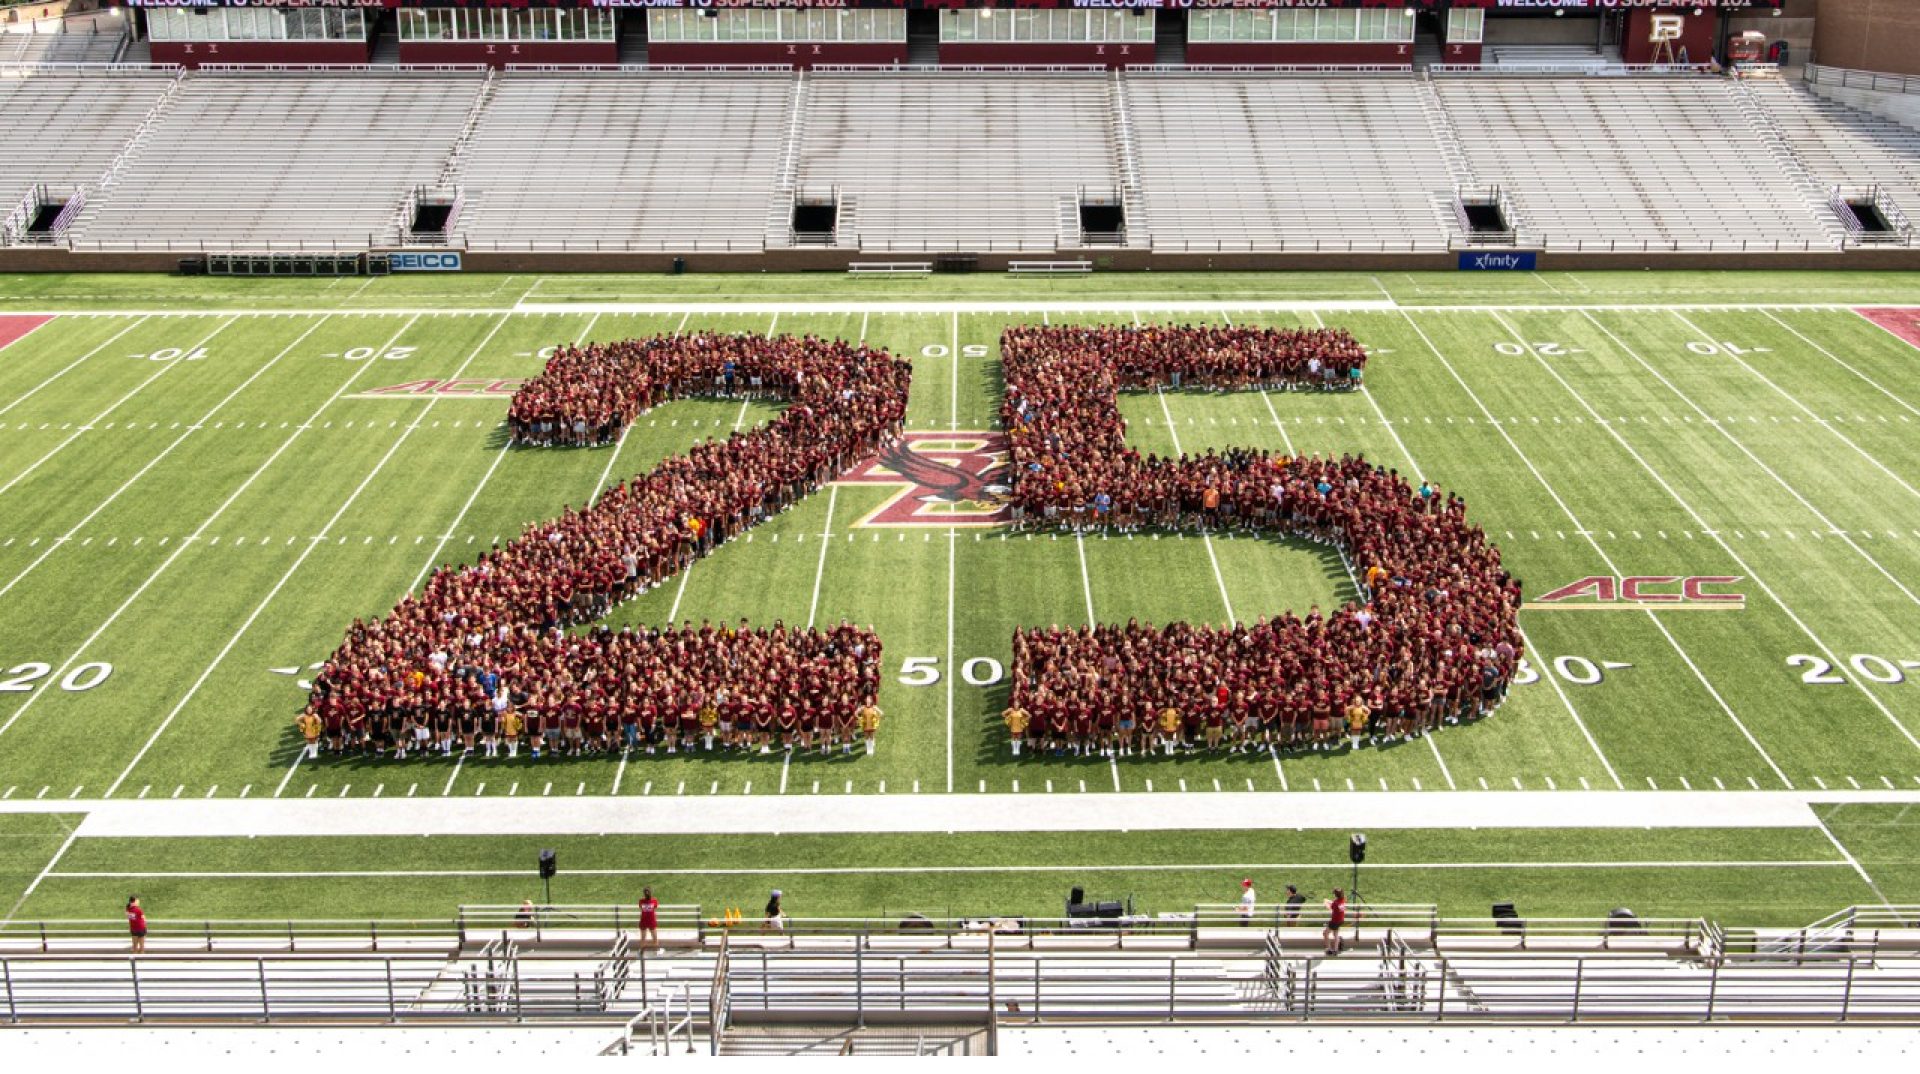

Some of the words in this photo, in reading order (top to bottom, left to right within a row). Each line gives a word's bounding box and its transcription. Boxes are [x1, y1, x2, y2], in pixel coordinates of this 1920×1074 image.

[388, 254, 459, 268] GEICO
[1475, 253, 1520, 270] xfinity
[149, 347, 208, 361] 10
[344, 346, 418, 361] 20
[921, 345, 989, 358] 50
[1493, 342, 1567, 355] 20
[1686, 341, 1751, 355] 10
[1532, 575, 1745, 602] ACC
[897, 656, 1004, 687] 50
[1786, 653, 1904, 684] 20
[0, 661, 114, 692] 20
